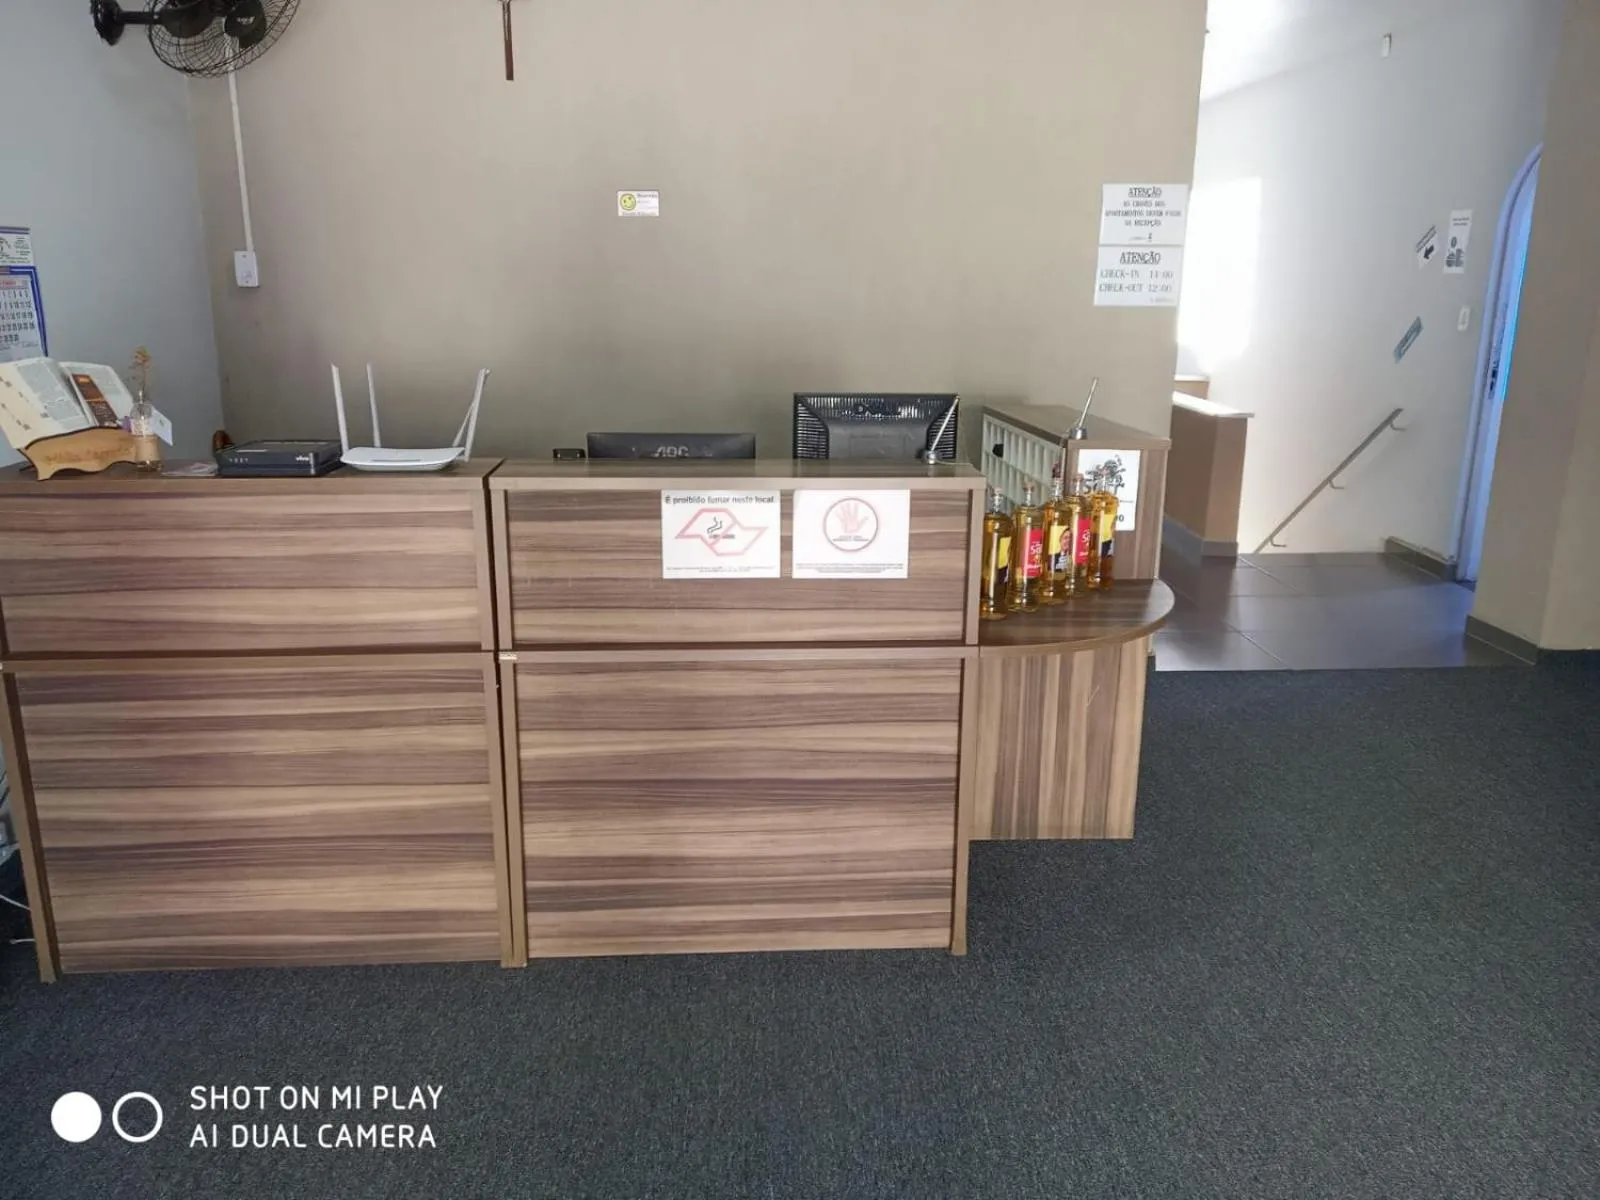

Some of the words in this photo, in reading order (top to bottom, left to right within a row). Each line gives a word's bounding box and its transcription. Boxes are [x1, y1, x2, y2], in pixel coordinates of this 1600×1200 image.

[1128, 186, 1161, 198] ATENÇÃO
[1119, 251, 1162, 265] ATENÇÃO
[1100, 269, 1140, 279] CHECK-IN
[1099, 283, 1143, 293] CHECK-OUT
[672, 495, 706, 505] proibido
[754, 495, 775, 504] local
